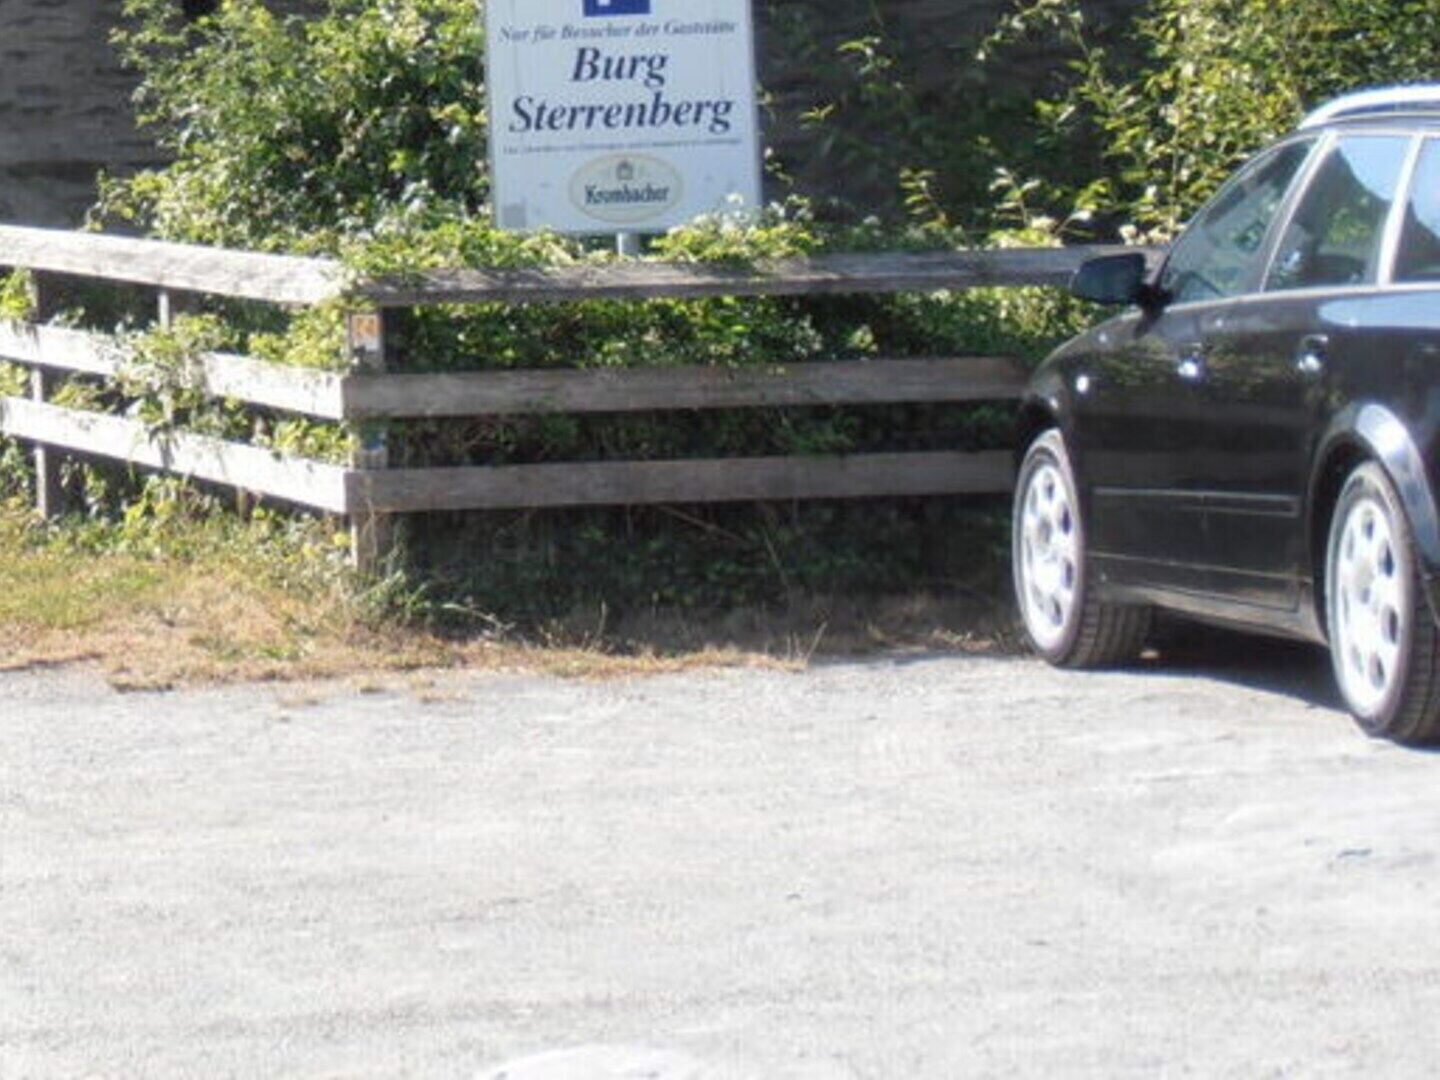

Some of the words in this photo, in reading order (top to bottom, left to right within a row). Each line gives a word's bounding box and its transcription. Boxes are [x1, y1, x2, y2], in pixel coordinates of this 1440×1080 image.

[499, 26, 530, 41] Nur
[635, 21, 659, 36] der
[571, 47, 668, 88] Burg
[509, 92, 734, 134] Sterrenberg
